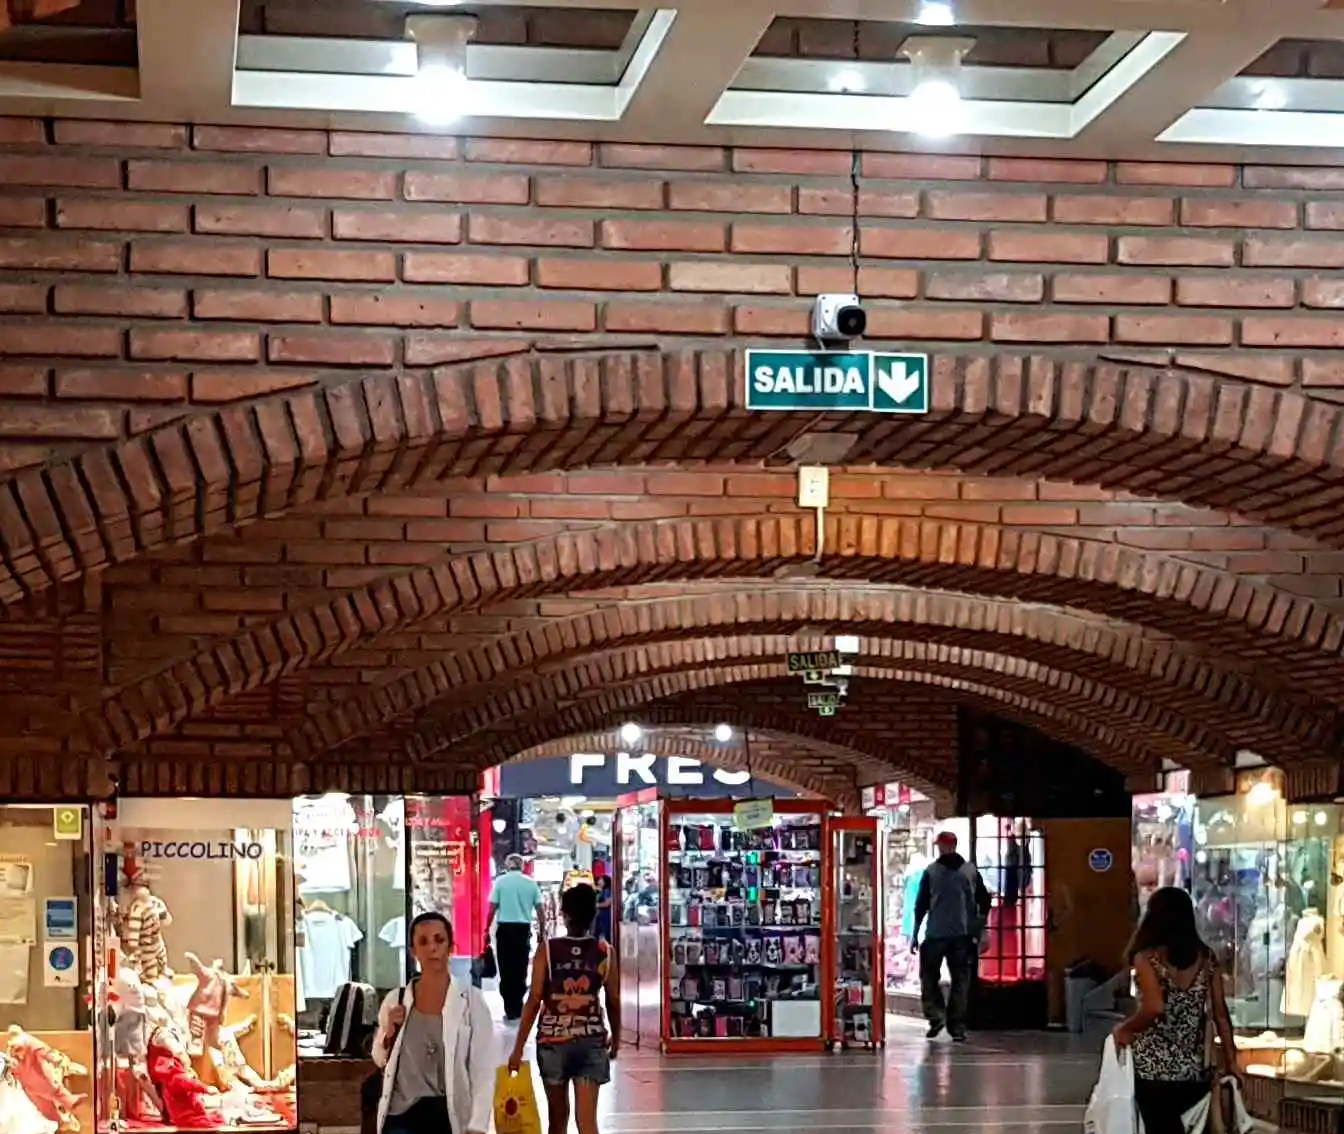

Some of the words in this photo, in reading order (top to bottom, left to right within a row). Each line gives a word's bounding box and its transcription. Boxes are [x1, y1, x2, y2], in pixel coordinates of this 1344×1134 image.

[753, 366, 865, 394] SALIDA
[789, 653, 838, 670] SALIDA
[141, 841, 262, 859] PICCOLINO
